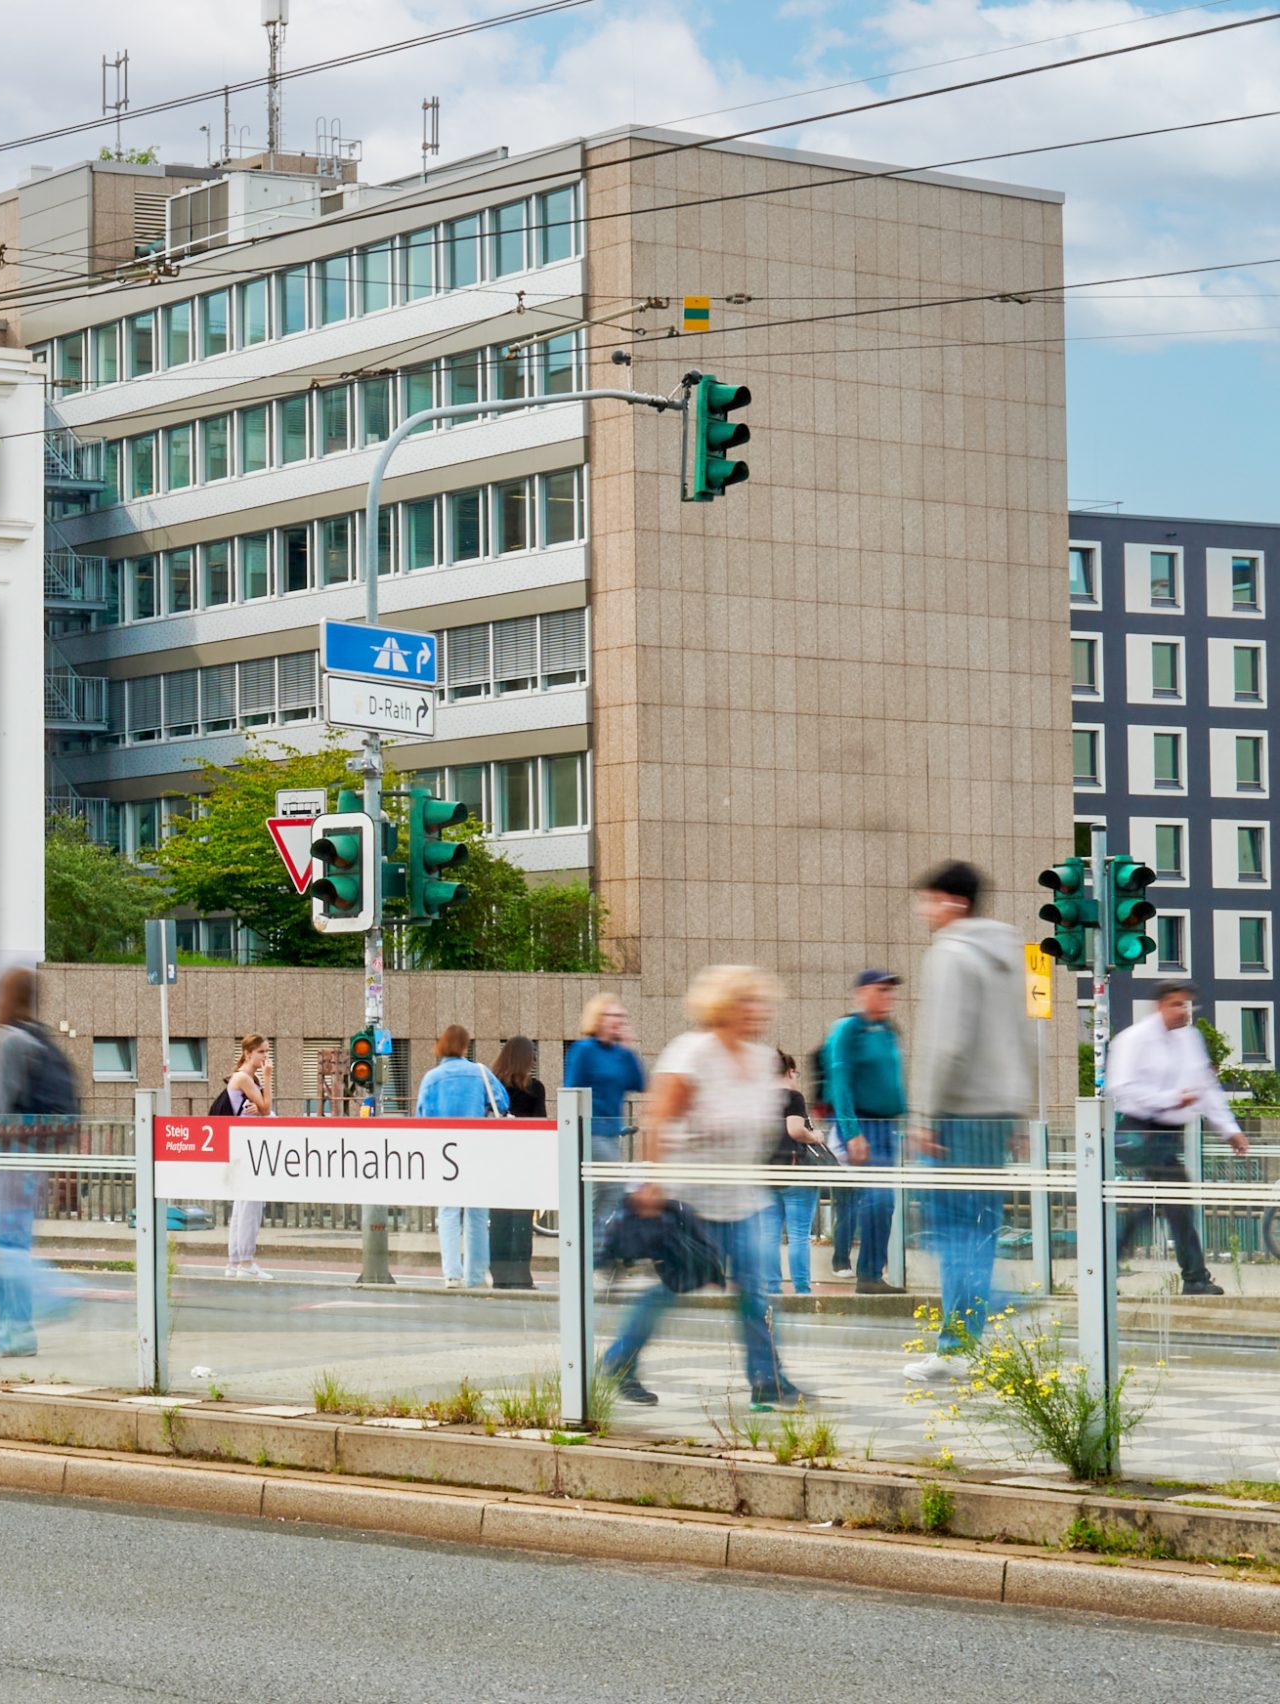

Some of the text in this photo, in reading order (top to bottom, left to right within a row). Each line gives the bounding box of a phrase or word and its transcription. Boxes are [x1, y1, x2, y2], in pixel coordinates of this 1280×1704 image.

[369, 695, 412, 720] D-Rath
[165, 1124, 189, 1141] Steig
[200, 1125, 214, 1152] 2
[165, 1141, 196, 1153] Platform
[247, 1138, 460, 1181] Wehrhahn S
